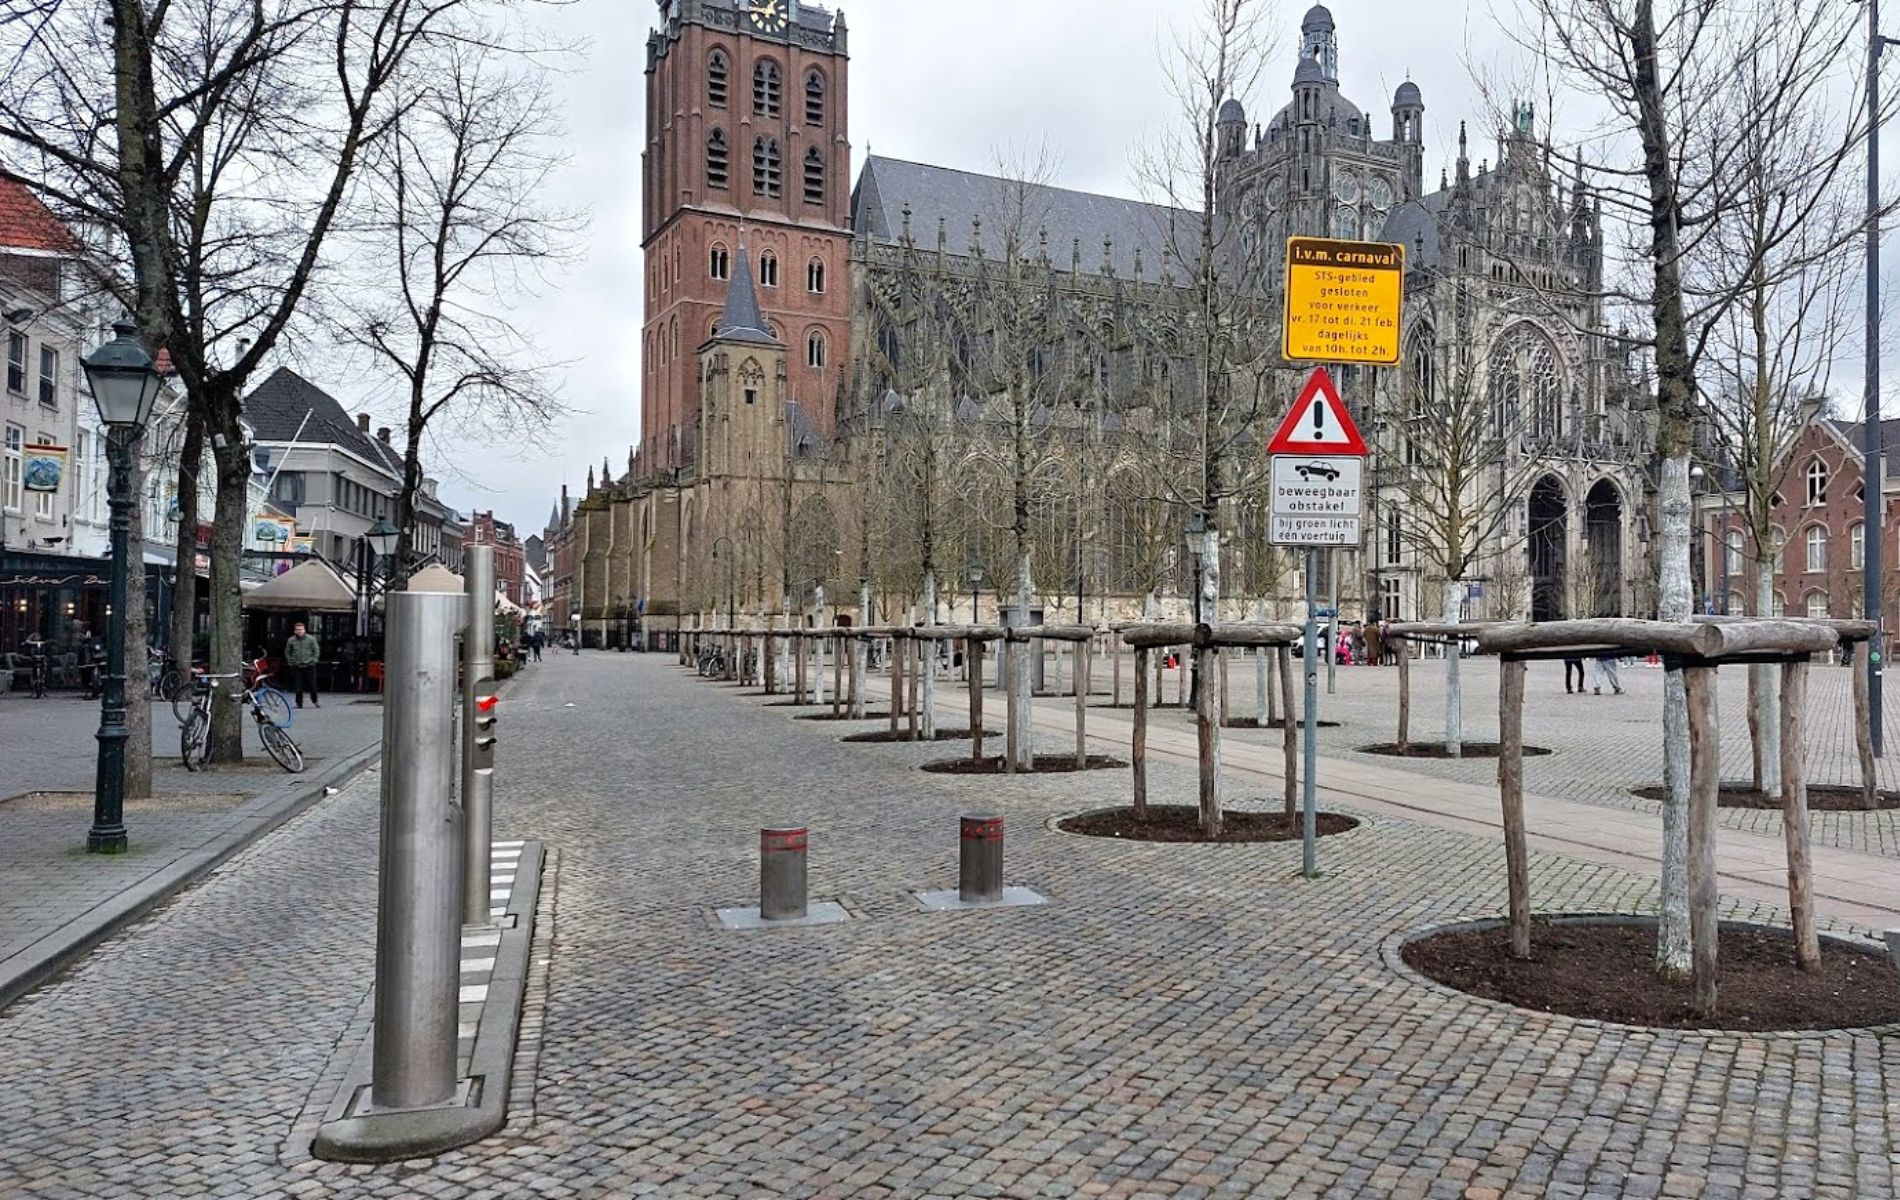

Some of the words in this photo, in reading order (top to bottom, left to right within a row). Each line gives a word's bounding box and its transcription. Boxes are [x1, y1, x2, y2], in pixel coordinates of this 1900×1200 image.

[1295, 247, 1331, 261] i.v.m.
[1336, 251, 1395, 265] carnaval
[1314, 271, 1375, 284] STS-gebied
[1320, 287, 1369, 298] gesloten
[1309, 302, 1334, 311] voor
[1337, 302, 1379, 313] verkeer
[1309, 314, 1320, 323] 17
[1323, 315, 1339, 325] tot
[1359, 316, 1371, 326] 21
[1375, 317, 1397, 328] feb.
[1317, 329, 1369, 342] dagelijks
[1303, 344, 1322, 353] van
[1351, 345, 1367, 355] tot
[1278, 486, 1357, 498] beweegbaar
[1289, 500, 1345, 511] obstakel
[1279, 519, 1292, 530] bij
[1296, 520, 1326, 530] groen
[1330, 519, 1354, 529] licht
[1301, 531, 1346, 543] voertuig
